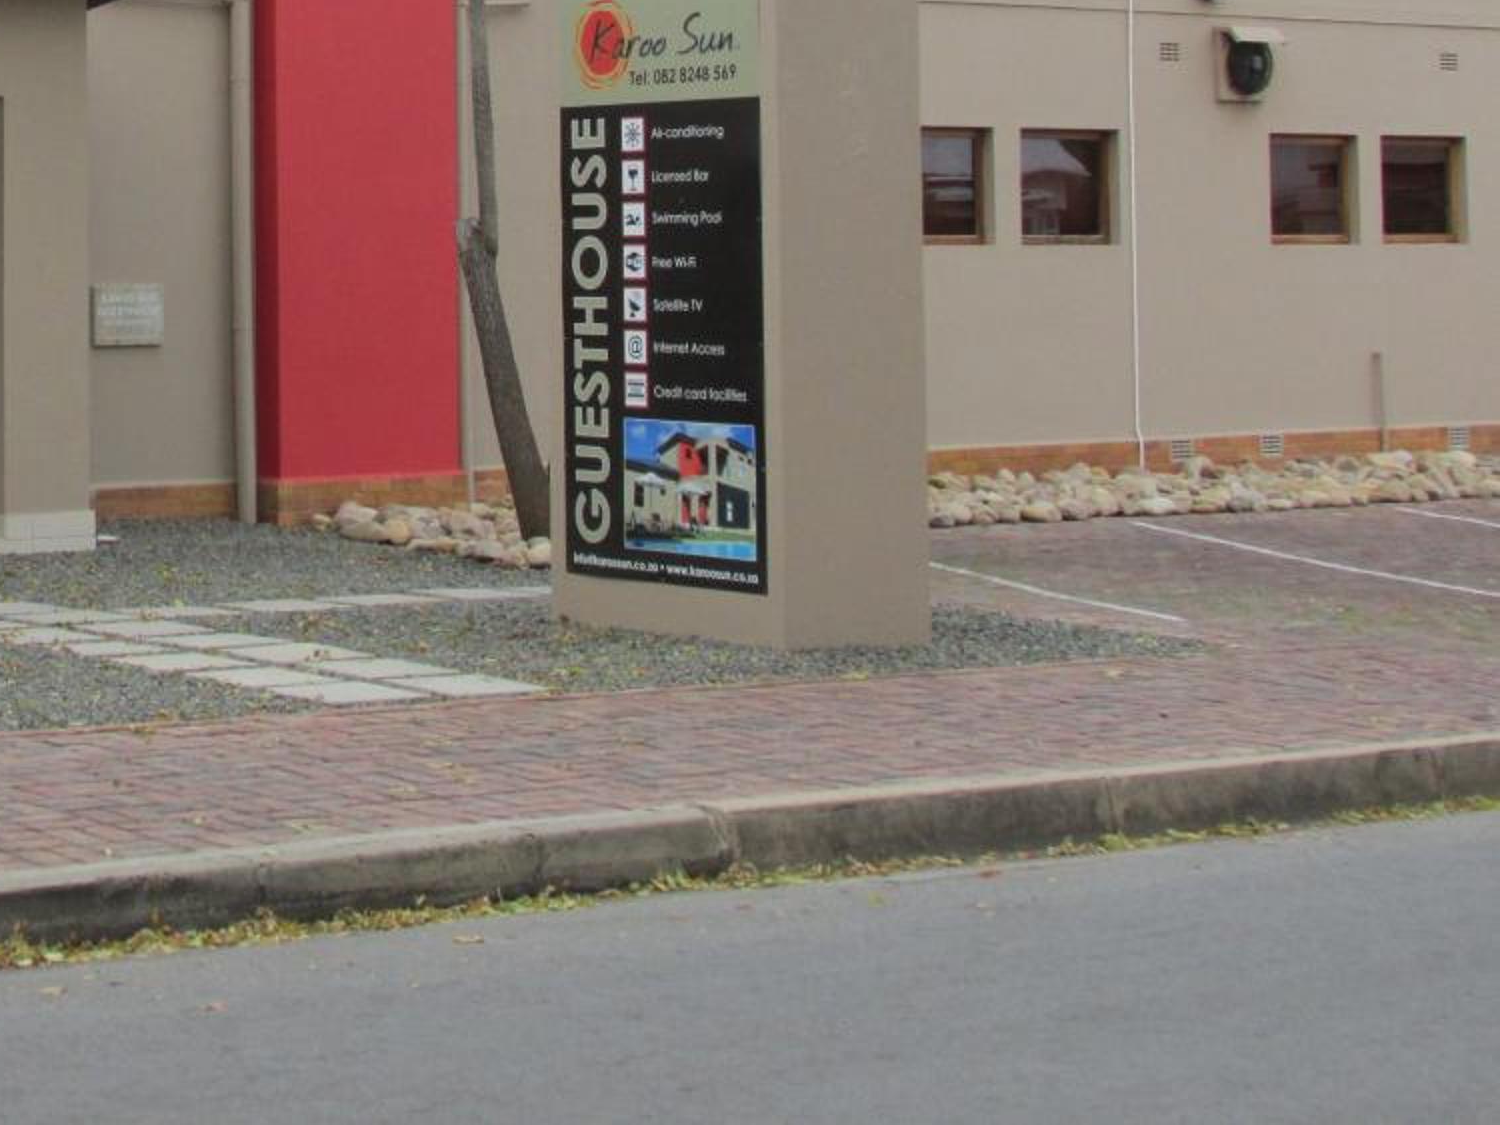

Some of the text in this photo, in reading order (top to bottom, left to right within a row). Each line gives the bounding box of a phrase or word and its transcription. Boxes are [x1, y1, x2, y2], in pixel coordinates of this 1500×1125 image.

[588, 11, 733, 66] Karoo Sun
[630, 71, 650, 86] Tel:
[680, 66, 710, 84] 8248
[713, 63, 737, 81] 569
[651, 125, 725, 140] Air-conditioning
[651, 168, 709, 183] Licensed Bar
[652, 210, 722, 226] Swimming Pool
[652, 256, 674, 268] Free
[653, 298, 703, 312] Satellite TV
[570, 117, 612, 544] GUESTHOUSE
[653, 341, 725, 356] Internet Access
[653, 385, 747, 403] Credit card facilities
